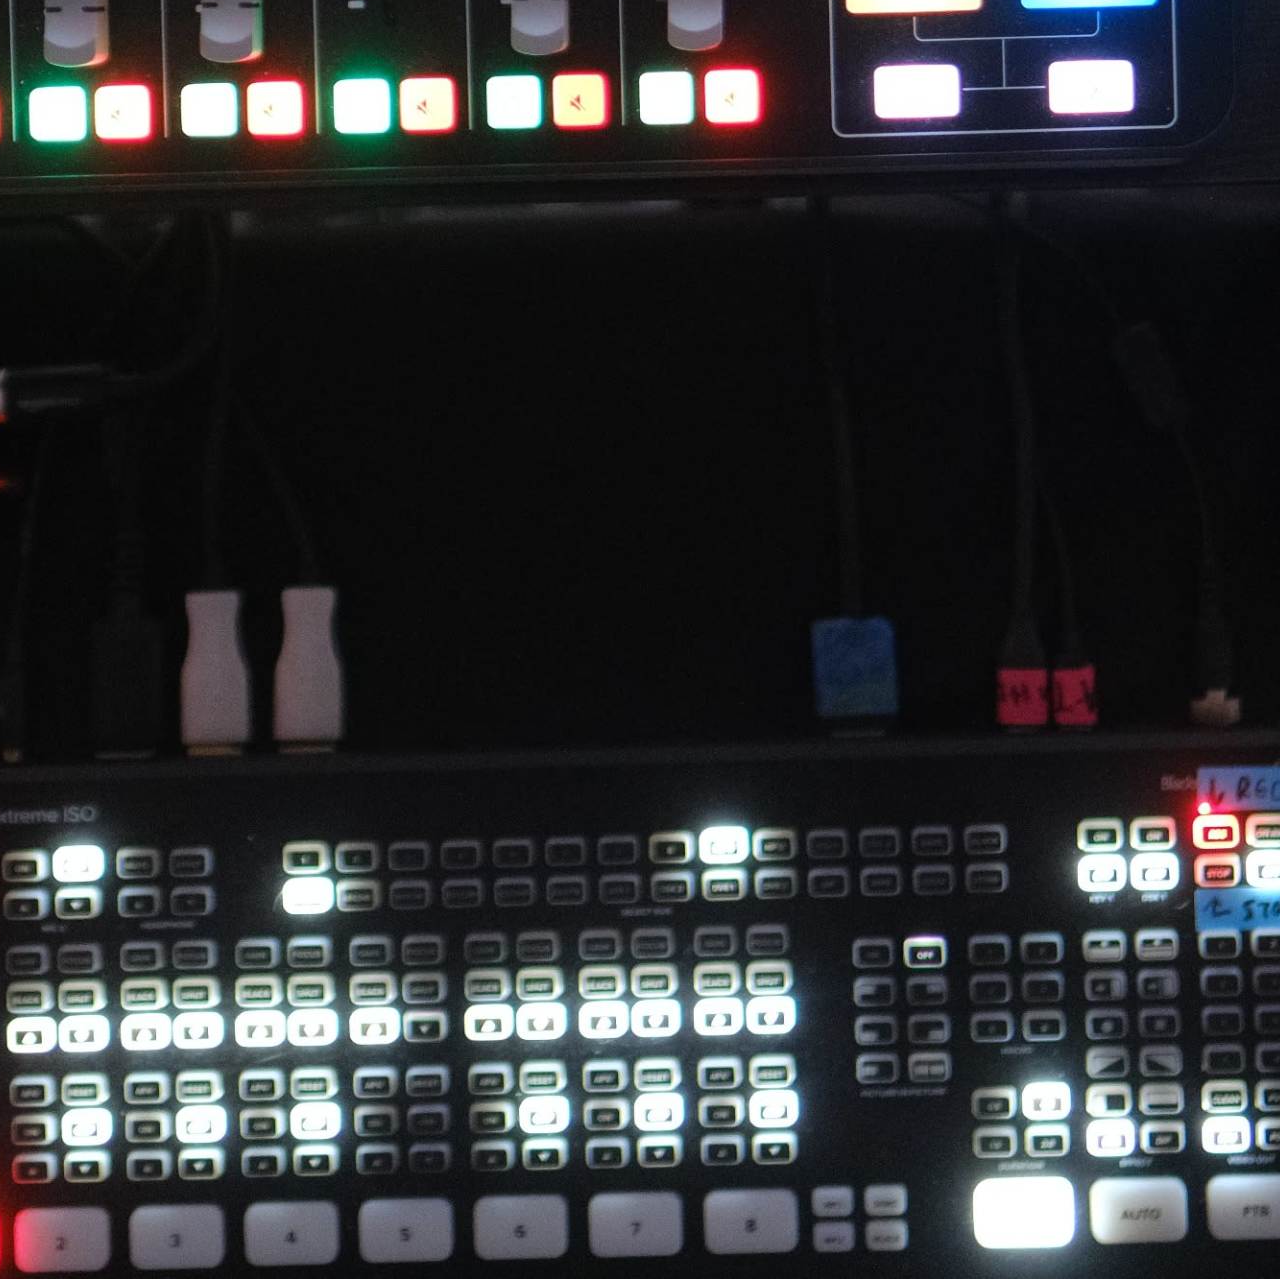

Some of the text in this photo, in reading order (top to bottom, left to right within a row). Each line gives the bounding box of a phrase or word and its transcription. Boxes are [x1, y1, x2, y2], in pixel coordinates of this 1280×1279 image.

[63, 804, 97, 823] ISO
[916, 951, 934, 960] OFF
[514, 1224, 526, 1238] 6
[631, 1222, 641, 1235] 7
[745, 1220, 757, 1233] 8
[169, 1234, 181, 1248] 3
[283, 1231, 296, 1246] 4
[399, 1227, 411, 1242] 5
[55, 1237, 65, 1250] 2
